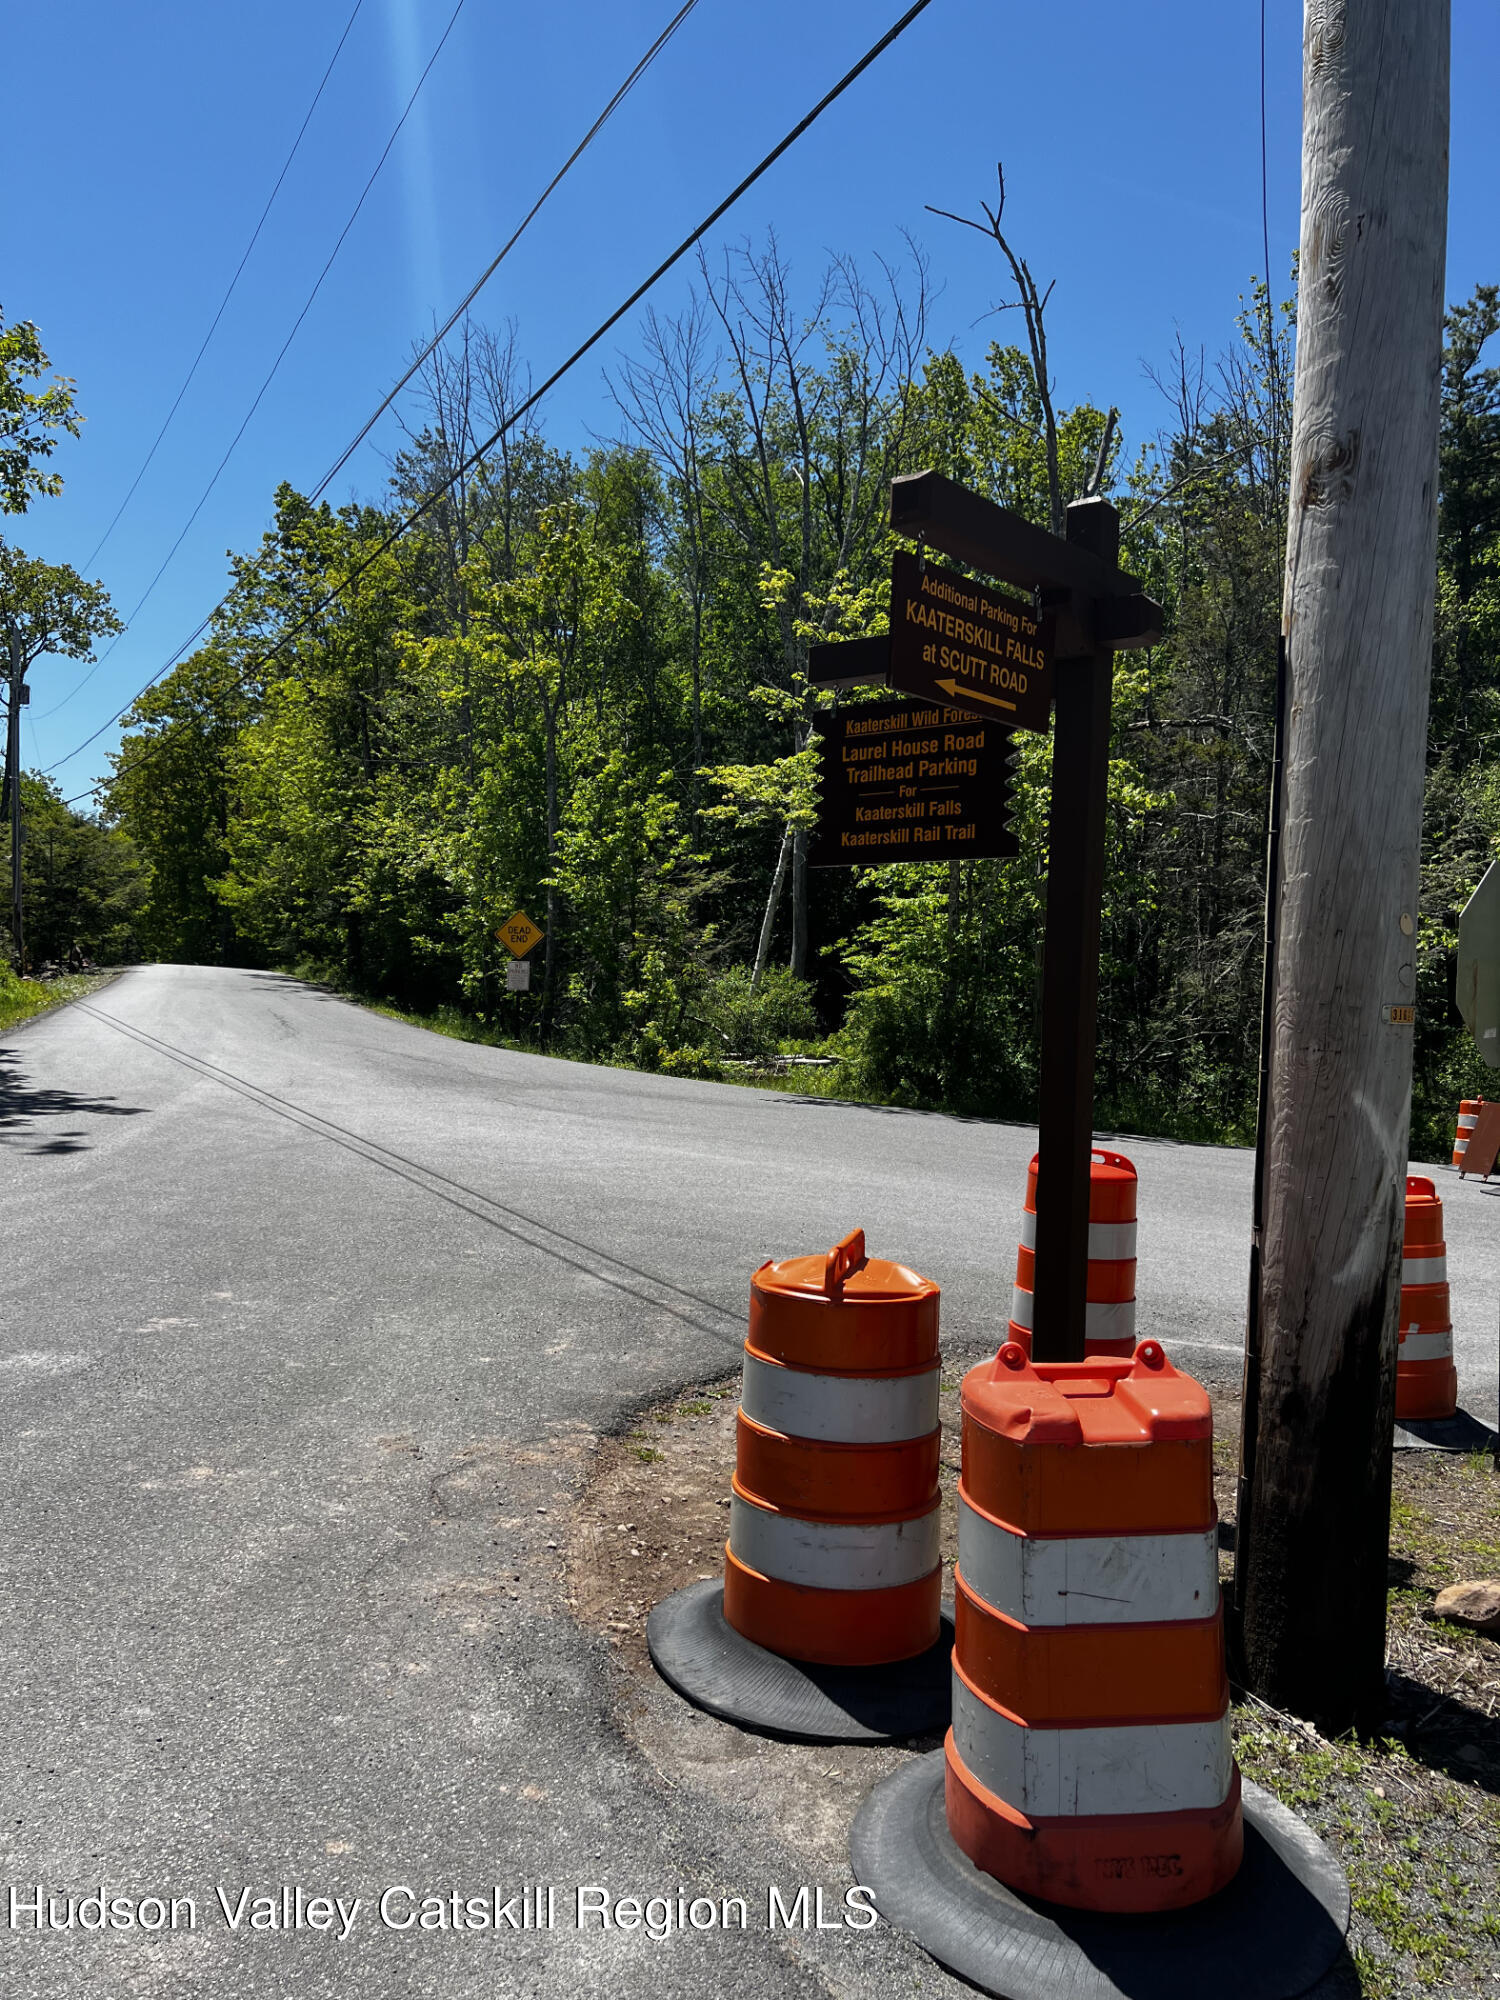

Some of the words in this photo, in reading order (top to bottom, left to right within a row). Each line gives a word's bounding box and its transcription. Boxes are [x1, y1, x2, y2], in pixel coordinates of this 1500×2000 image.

[921, 575, 978, 613] Additional
[981, 599, 1018, 633] Parking
[1021, 616, 1037, 636] For
[906, 599, 1003, 655] KAATERSKILL
[1006, 638, 1045, 670] FALLS
[922, 644, 937, 664] at
[940, 646, 987, 680] SCUTT
[990, 664, 1028, 694] ROAD
[845, 713, 908, 736] Kaaterskill
[912, 709, 939, 727] Wild
[842, 742, 887, 763] Laurel
[891, 738, 938, 757] House
[944, 731, 985, 751] Road
[846, 762, 913, 784] Trailhead
[918, 757, 977, 777] Parking
[899, 785, 917, 798] For
[855, 802, 924, 822] Kaaterskill
[929, 800, 962, 816] Falls
[841, 828, 909, 847] Kaaterskill
[913, 826, 940, 842] Rail
[945, 823, 976, 840] Trail
[507, 926, 531, 935] DEAD
[510, 935, 529, 943] END
